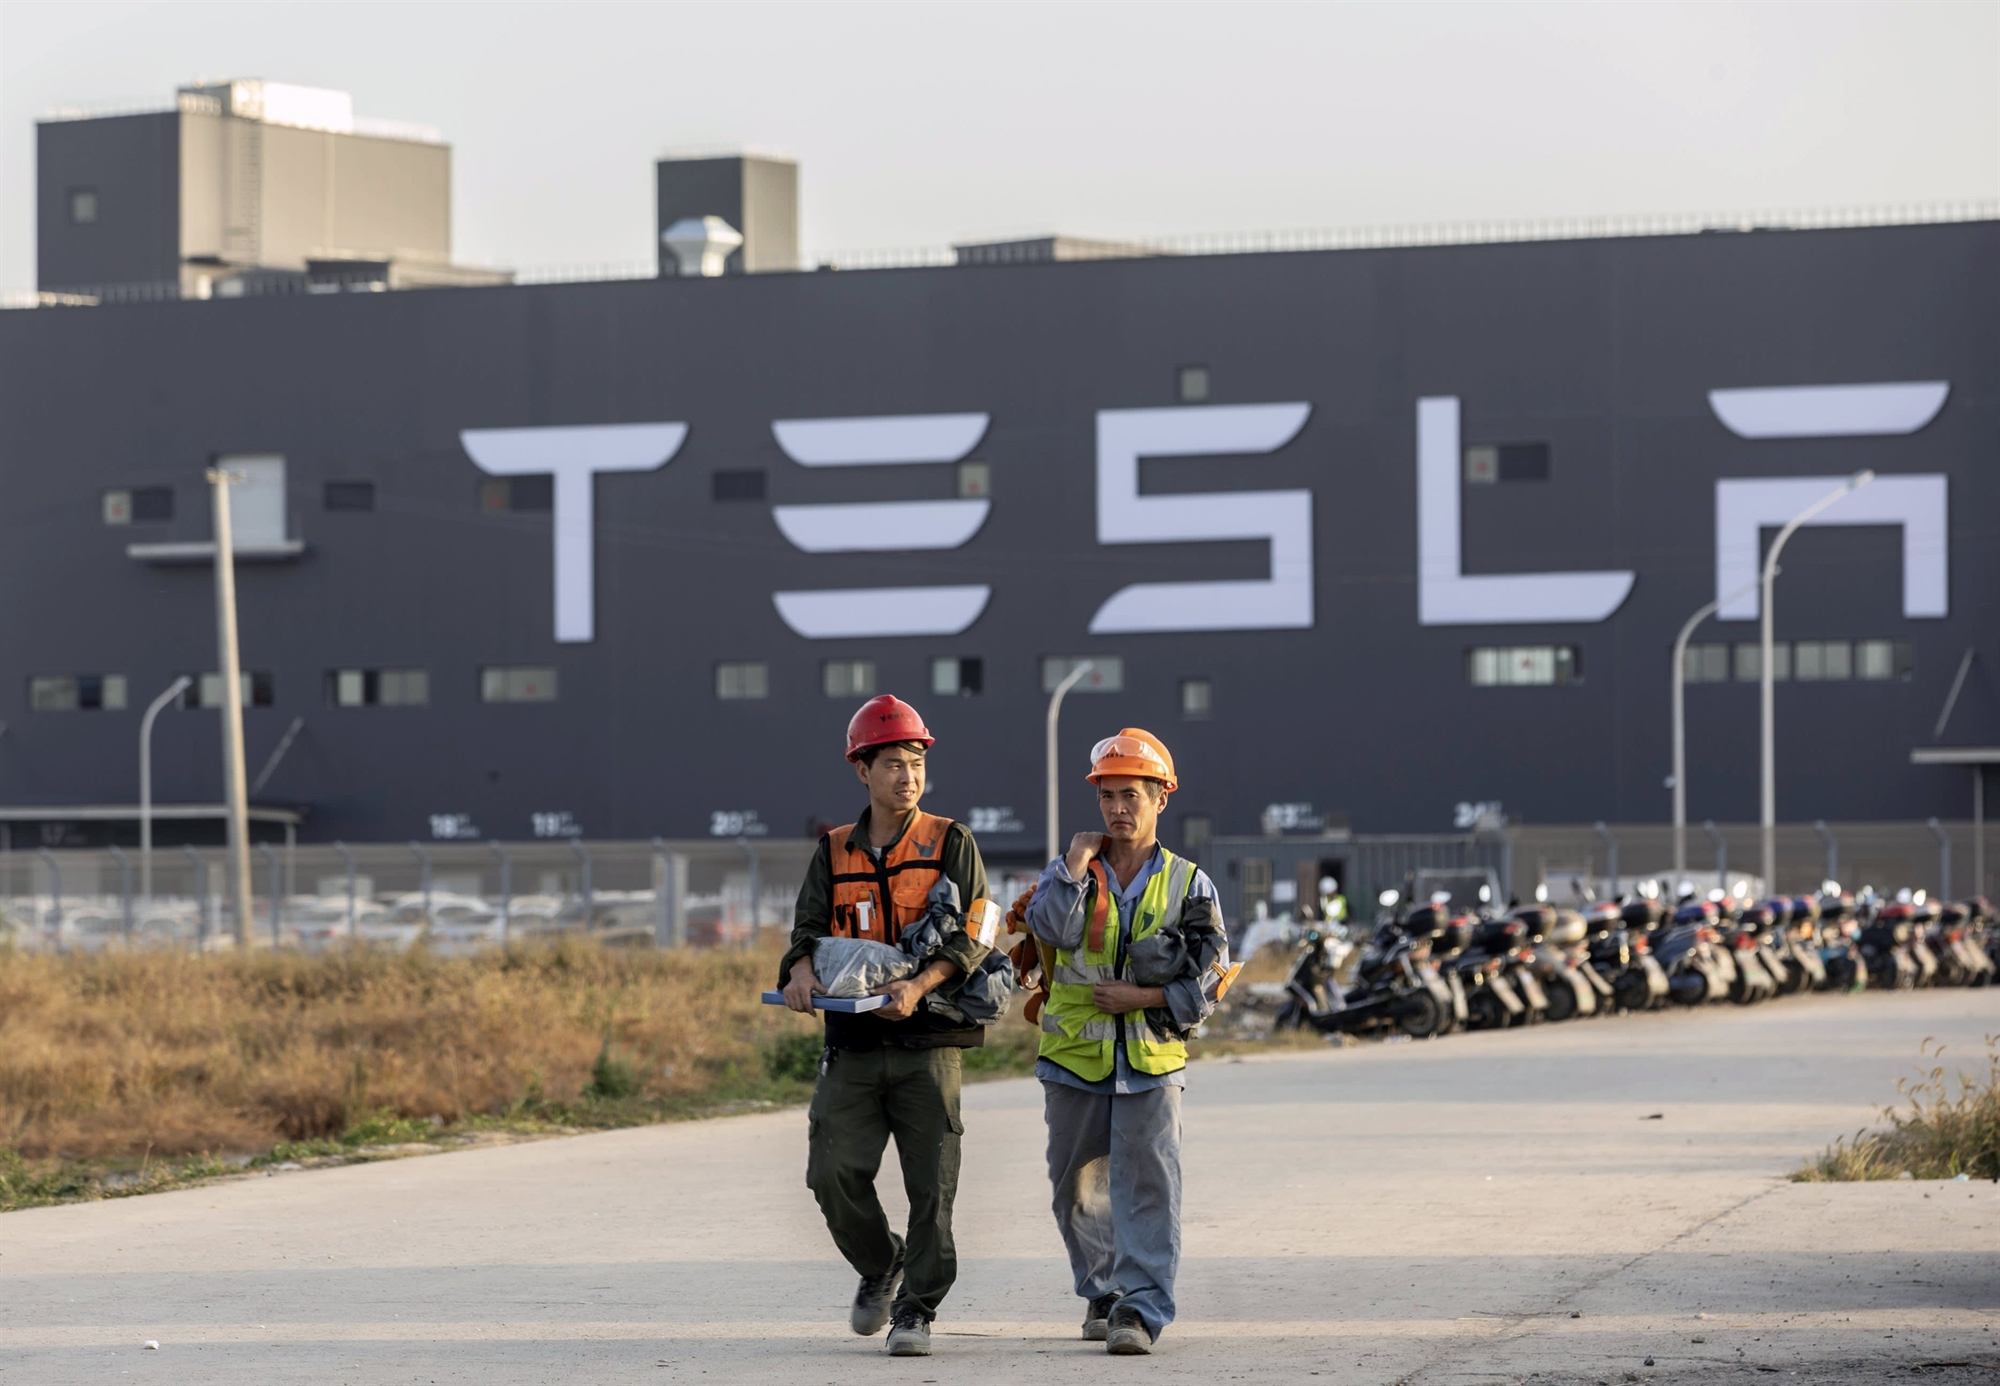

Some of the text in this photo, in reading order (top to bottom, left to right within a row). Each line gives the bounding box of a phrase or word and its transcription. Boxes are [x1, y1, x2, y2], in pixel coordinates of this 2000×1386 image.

[460, 380, 1950, 643] TESLA
[710, 811, 744, 837] 20
[969, 807, 998, 832] 22
